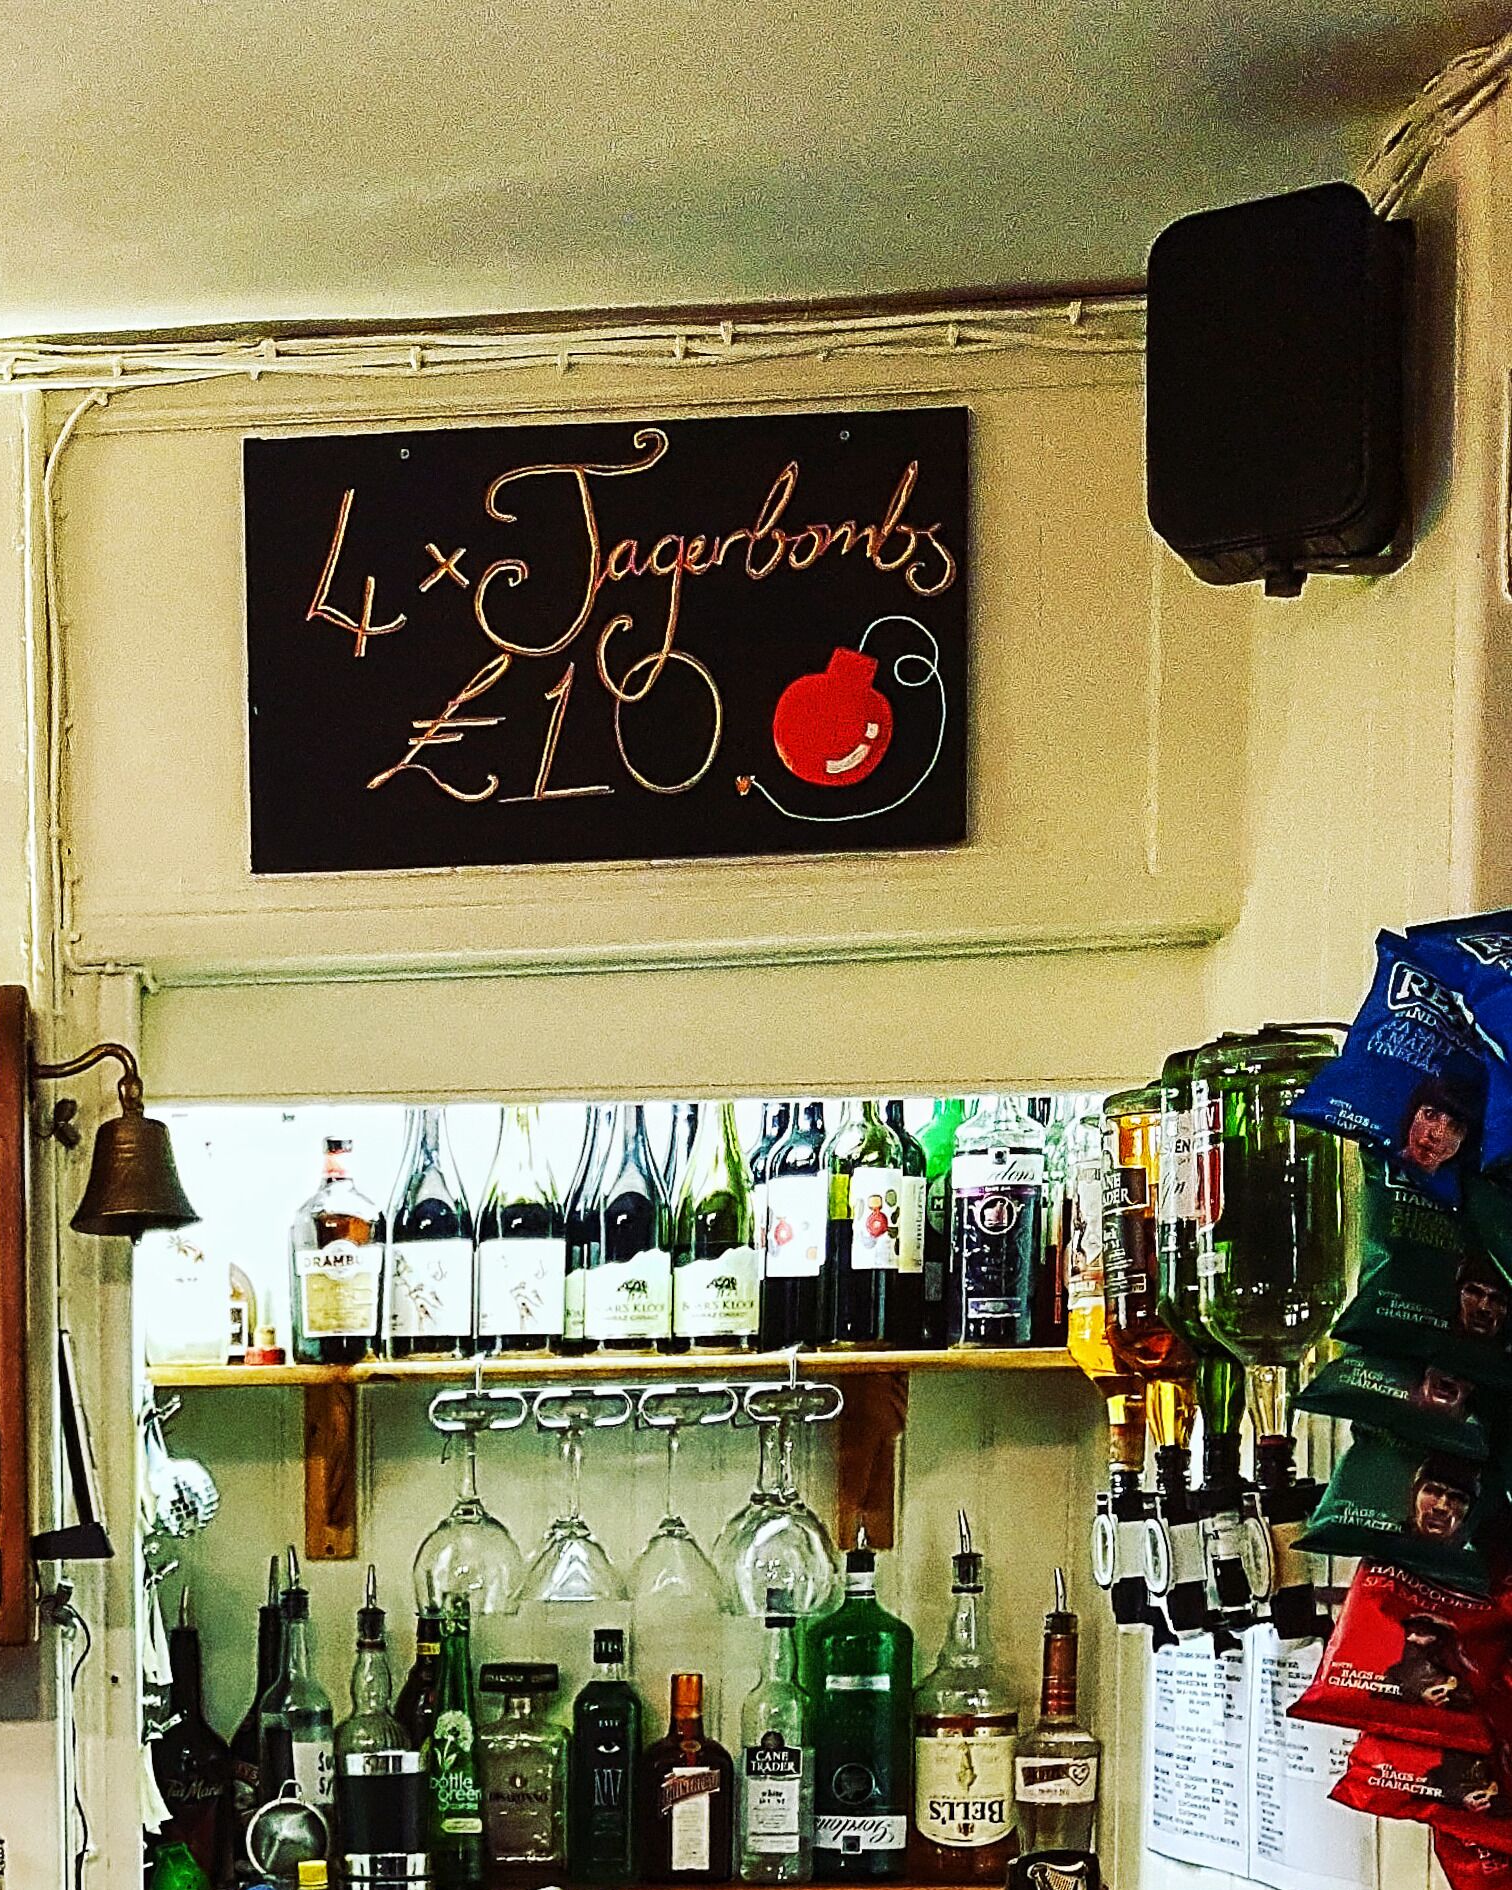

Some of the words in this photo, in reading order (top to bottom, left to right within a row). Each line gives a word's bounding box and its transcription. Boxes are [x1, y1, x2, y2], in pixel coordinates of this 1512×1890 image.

[306, 488, 407, 657] 4
[473, 427, 957, 701] Jagerbombs
[366, 652, 723, 803] £10
[1340, 1668, 1374, 1680] BAGS
[754, 1750, 789, 1763] CANE
[750, 1760, 796, 1774] TRADER
[1380, 1770, 1415, 1783] BAGS
[929, 1799, 1006, 1826] BELL'S
